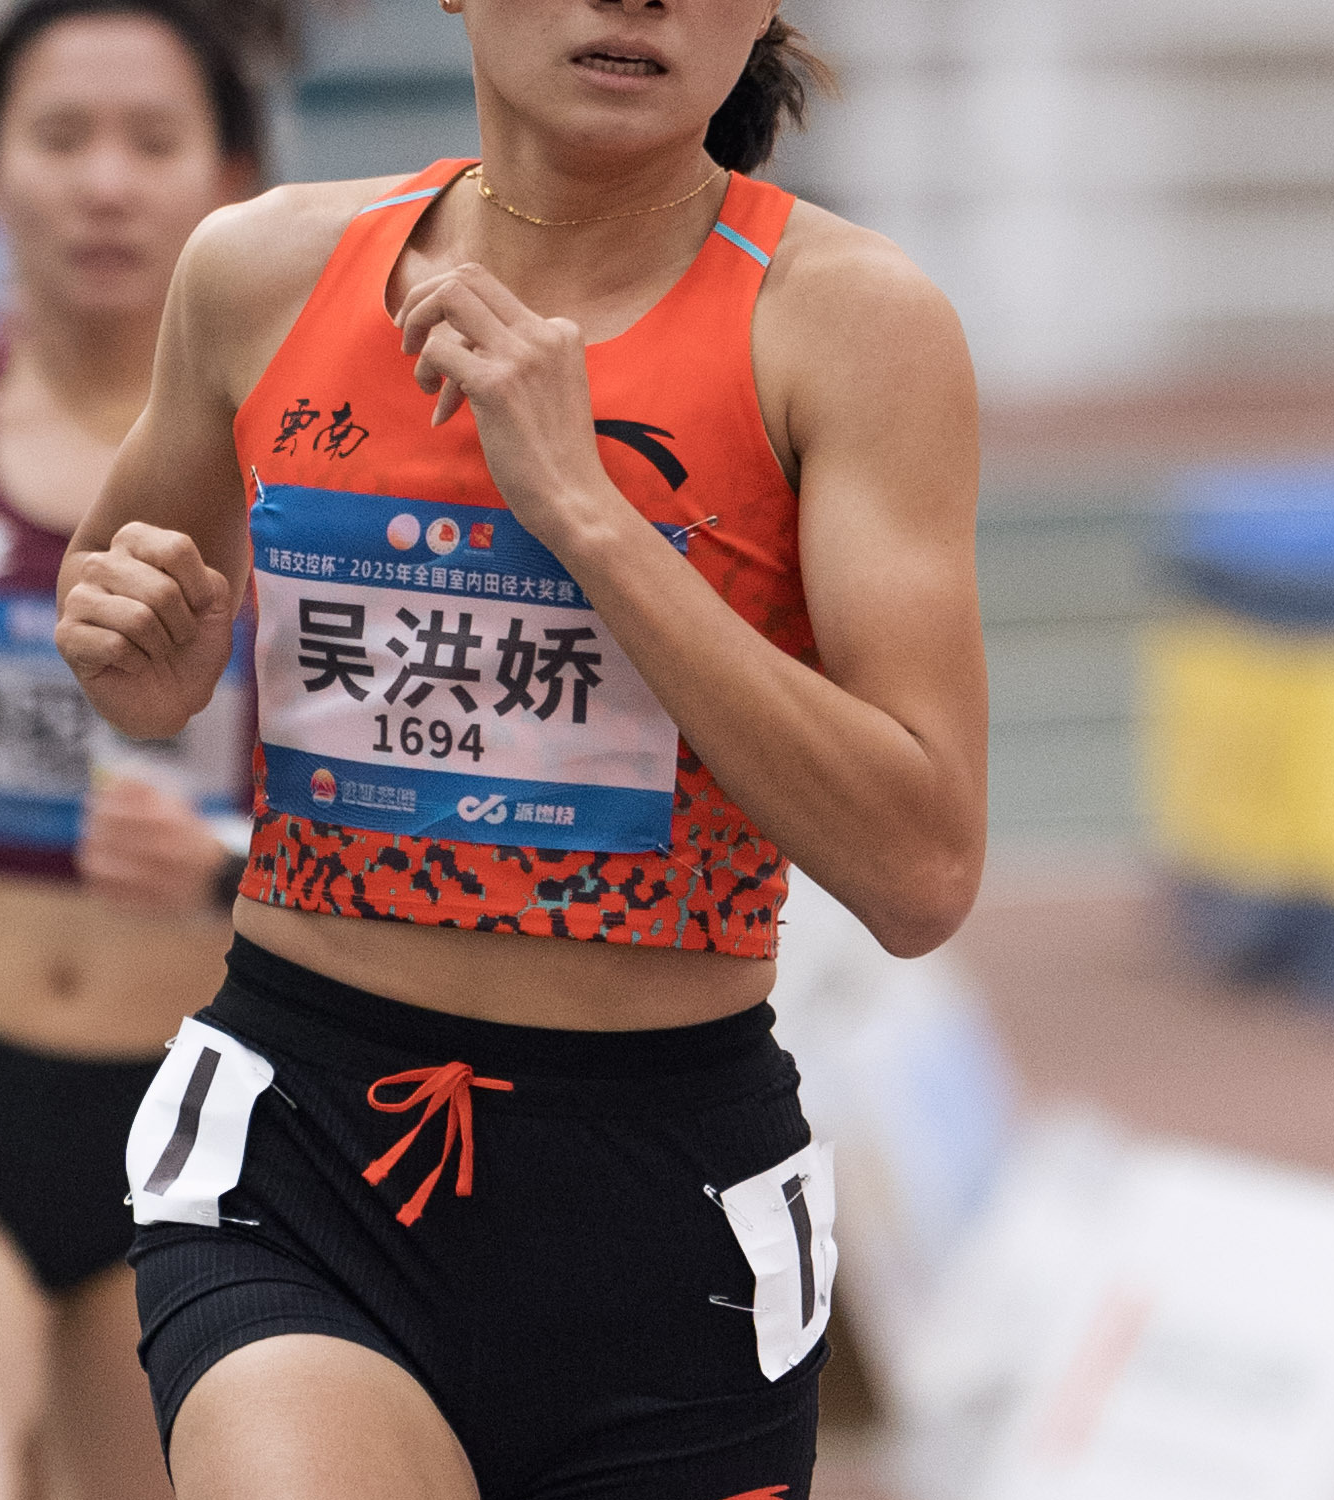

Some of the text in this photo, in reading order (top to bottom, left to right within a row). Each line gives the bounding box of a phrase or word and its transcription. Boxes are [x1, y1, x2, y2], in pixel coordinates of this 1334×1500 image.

[298, 598, 603, 724] 吴洪娇
[372, 714, 485, 762] 1694
[143, 1046, 222, 1197] 1
